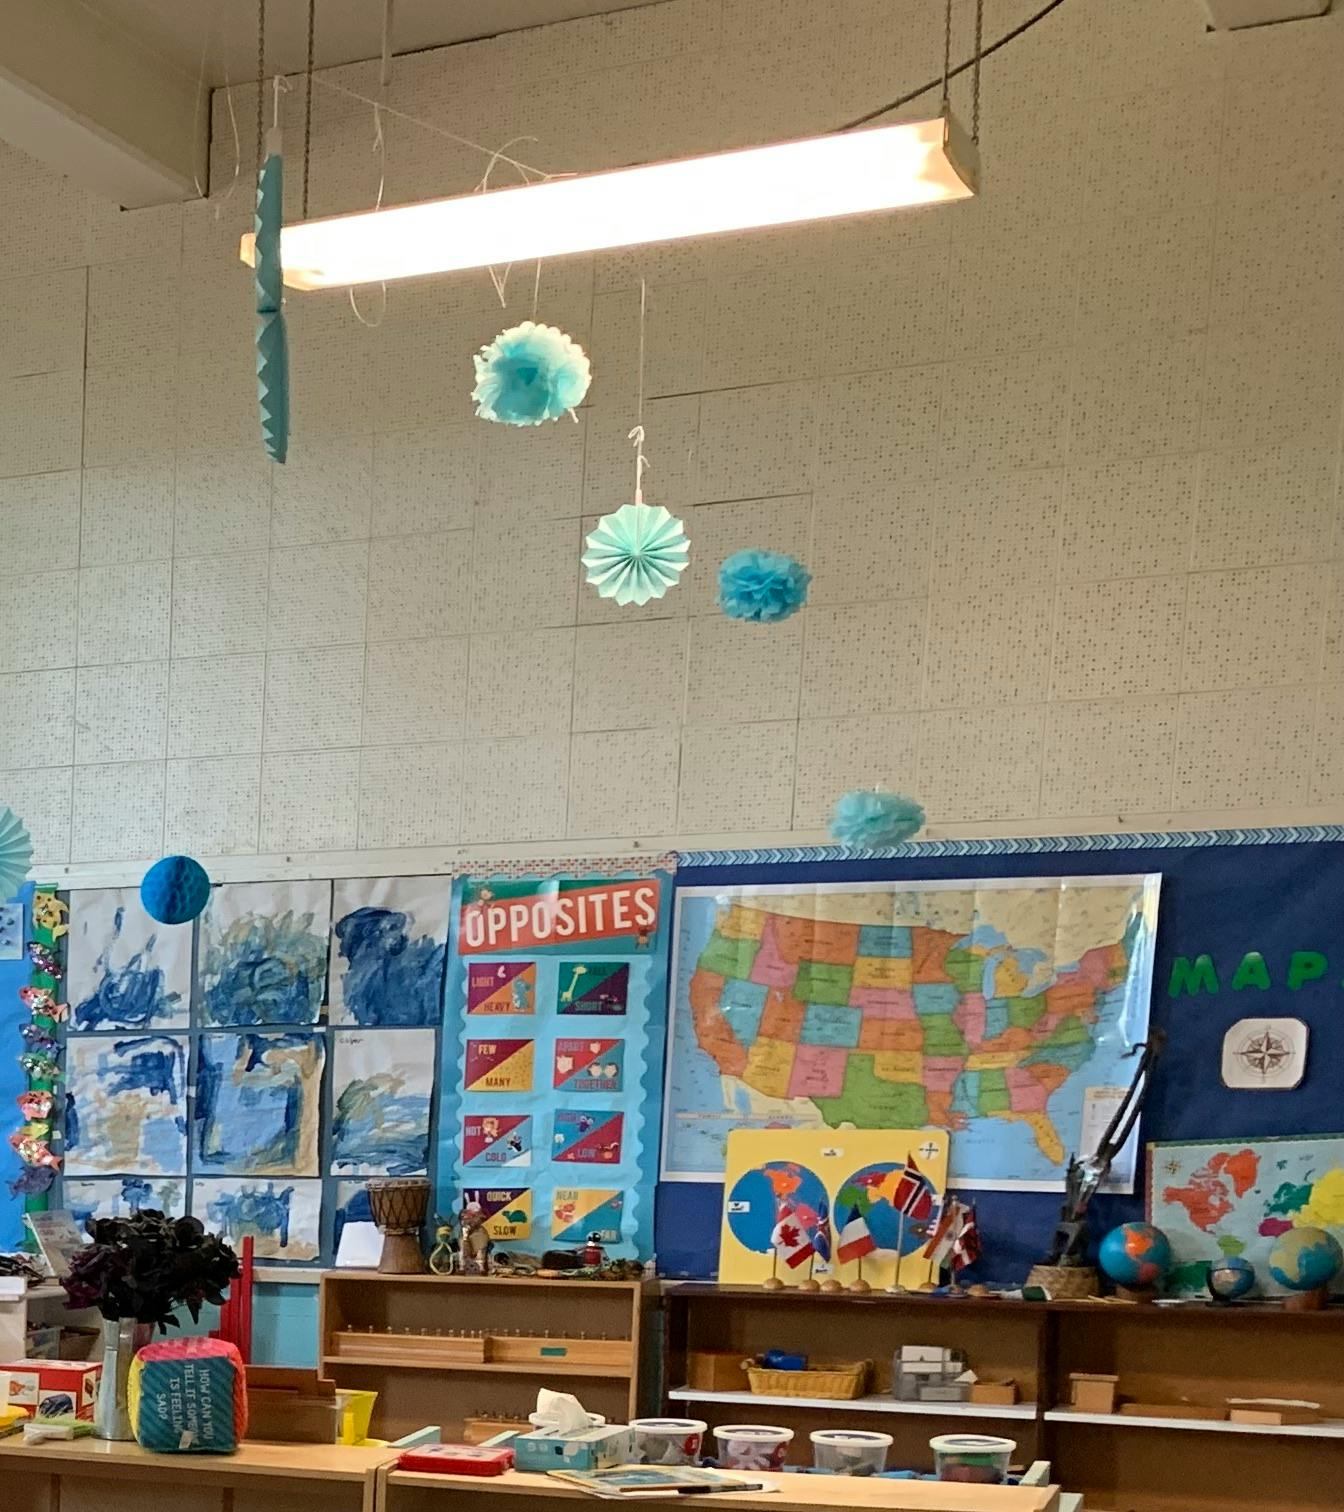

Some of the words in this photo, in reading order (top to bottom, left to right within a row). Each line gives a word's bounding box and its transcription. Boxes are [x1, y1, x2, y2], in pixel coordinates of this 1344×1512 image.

[465, 887, 656, 947] OPPOSITES
[1168, 951, 1344, 998] MAP
[472, 976, 495, 988] LIGHT
[484, 1001, 511, 1012] HEAVY
[478, 1044, 497, 1055] FEW
[485, 1077, 511, 1087] MANY
[466, 1125, 481, 1136] HOT
[485, 1152, 507, 1162] COLD
[578, 1148, 597, 1158] LOW
[487, 1191, 512, 1201] QUICK
[556, 1190, 579, 1200] NEAR
[493, 1225, 517, 1236] SLOW
[184, 1364, 194, 1386] TELL
[170, 1377, 181, 1391] IS
[199, 1369, 211, 1394] HOW
[156, 1393, 168, 1420] SAD?
[201, 1396, 212, 1418] CAN
[202, 1421, 214, 1440] YOU
